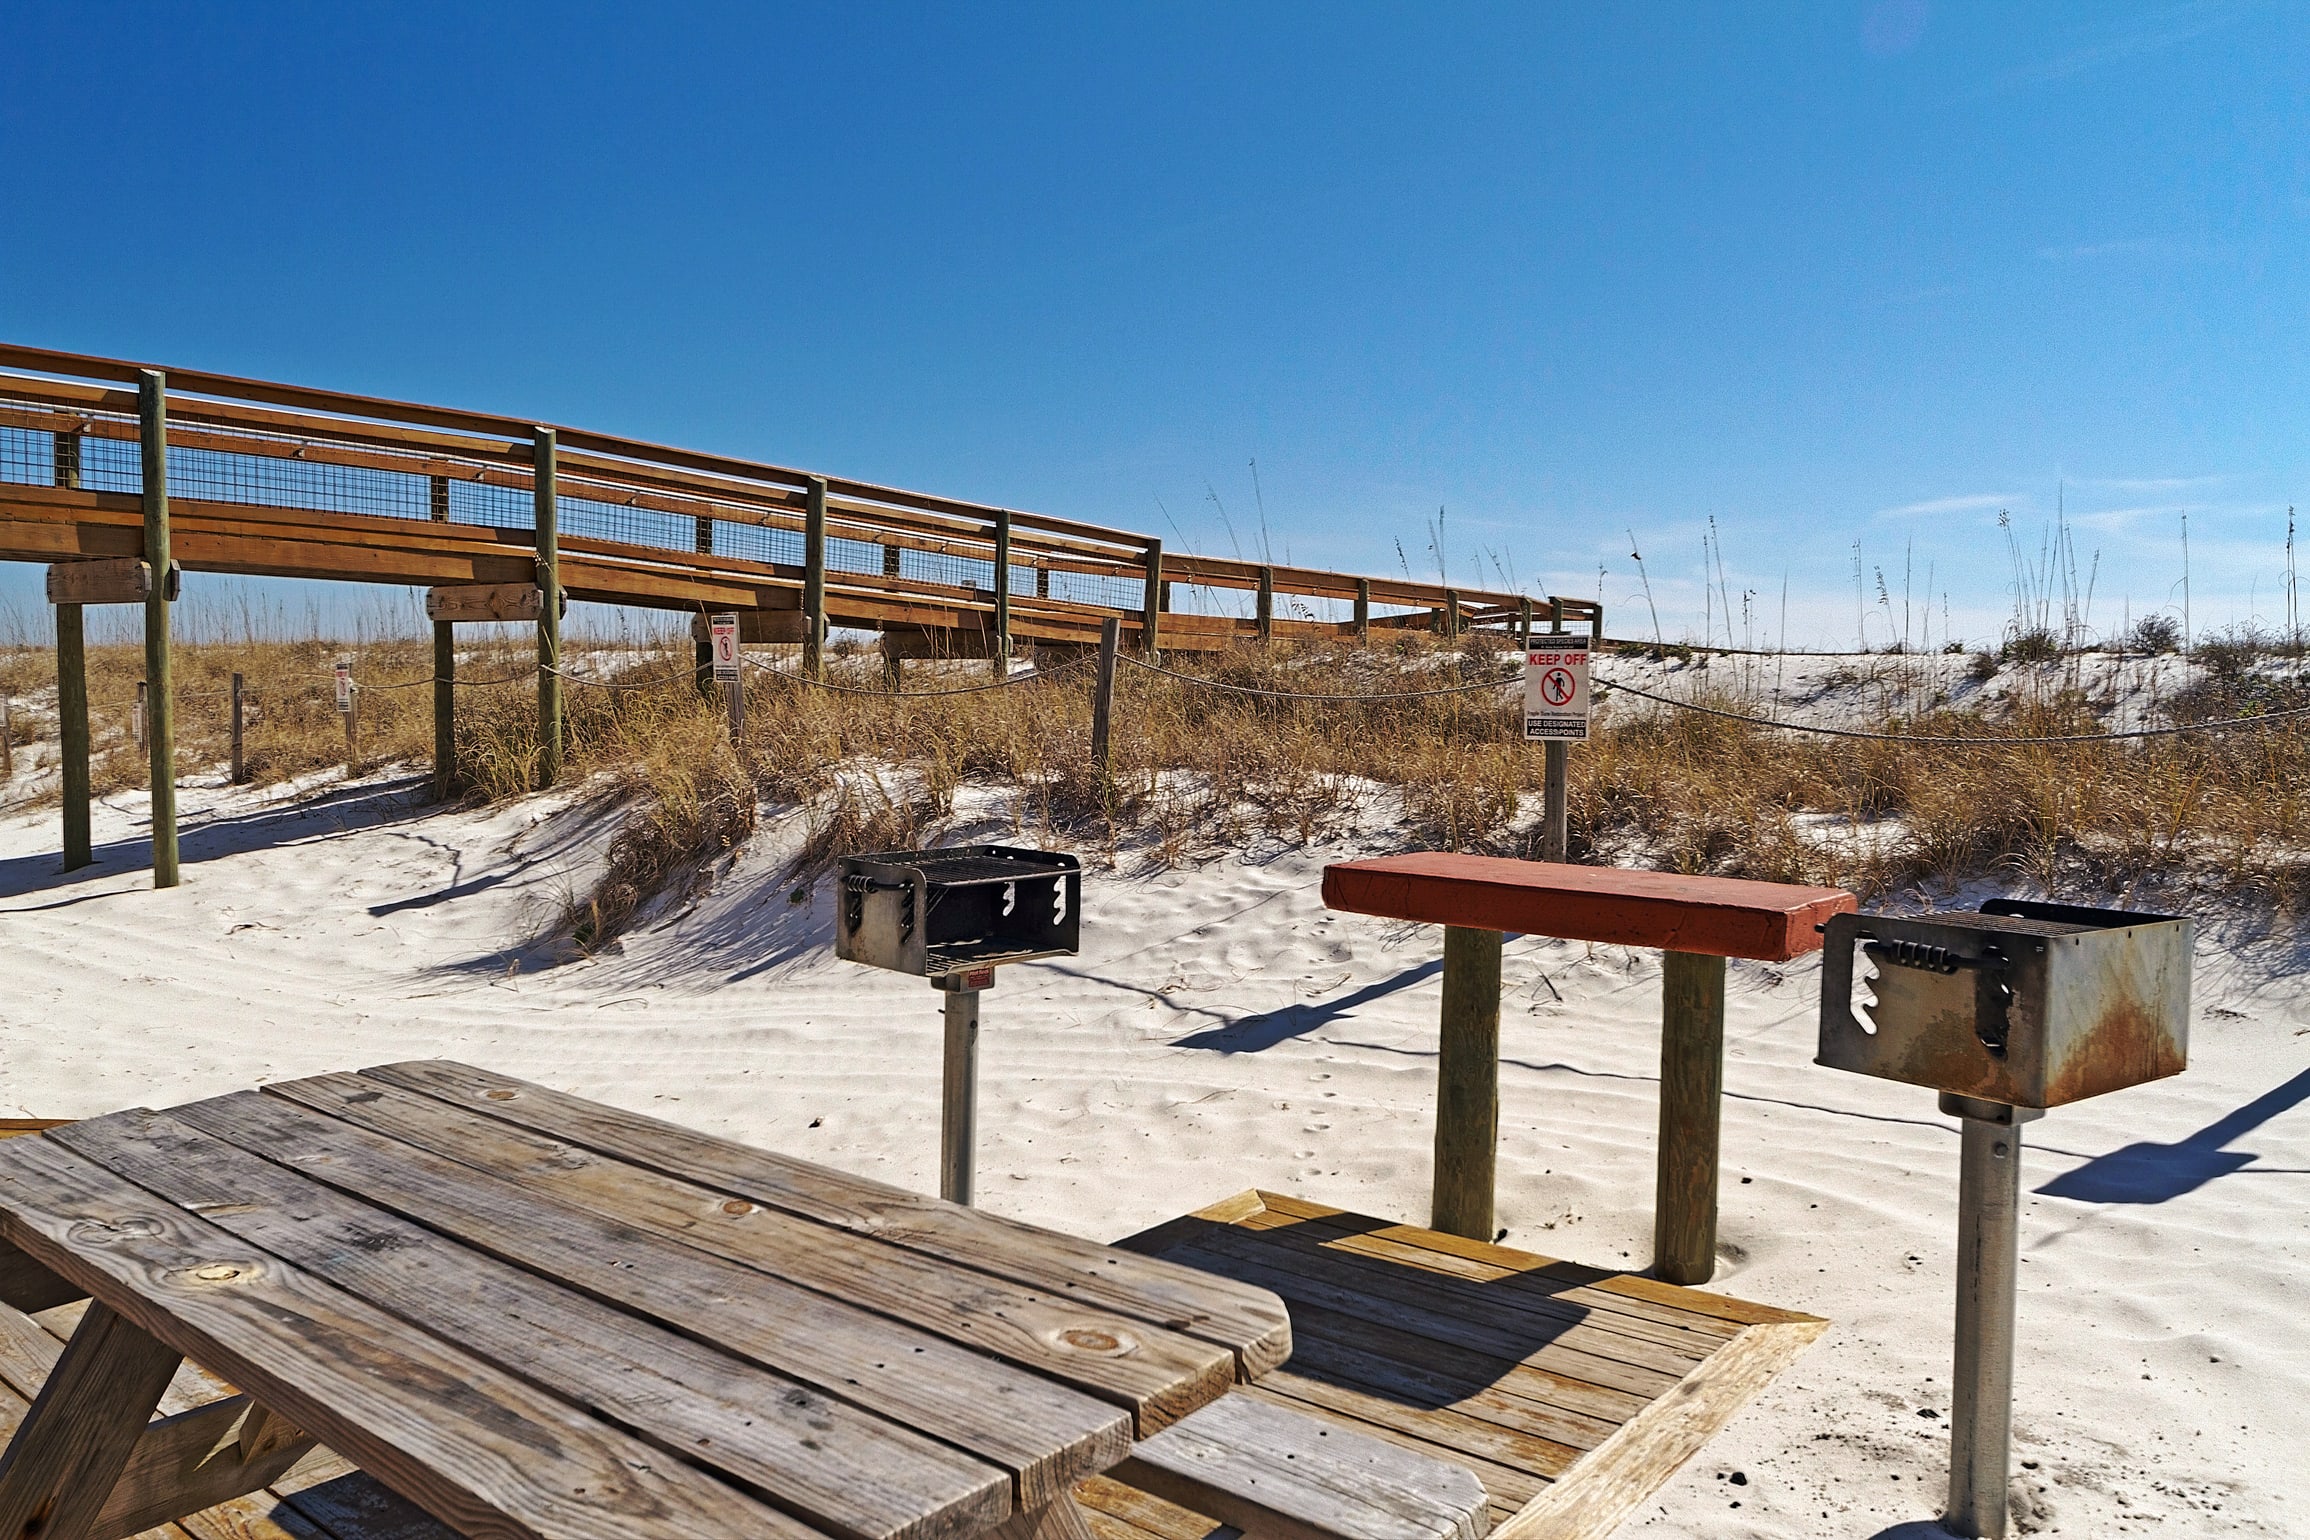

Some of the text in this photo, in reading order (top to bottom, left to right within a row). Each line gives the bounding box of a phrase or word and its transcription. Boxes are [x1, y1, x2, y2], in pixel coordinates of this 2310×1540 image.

[1529, 653, 1587, 665] KEEP OFF
[1543, 720, 1586, 728] DESIGNATED
